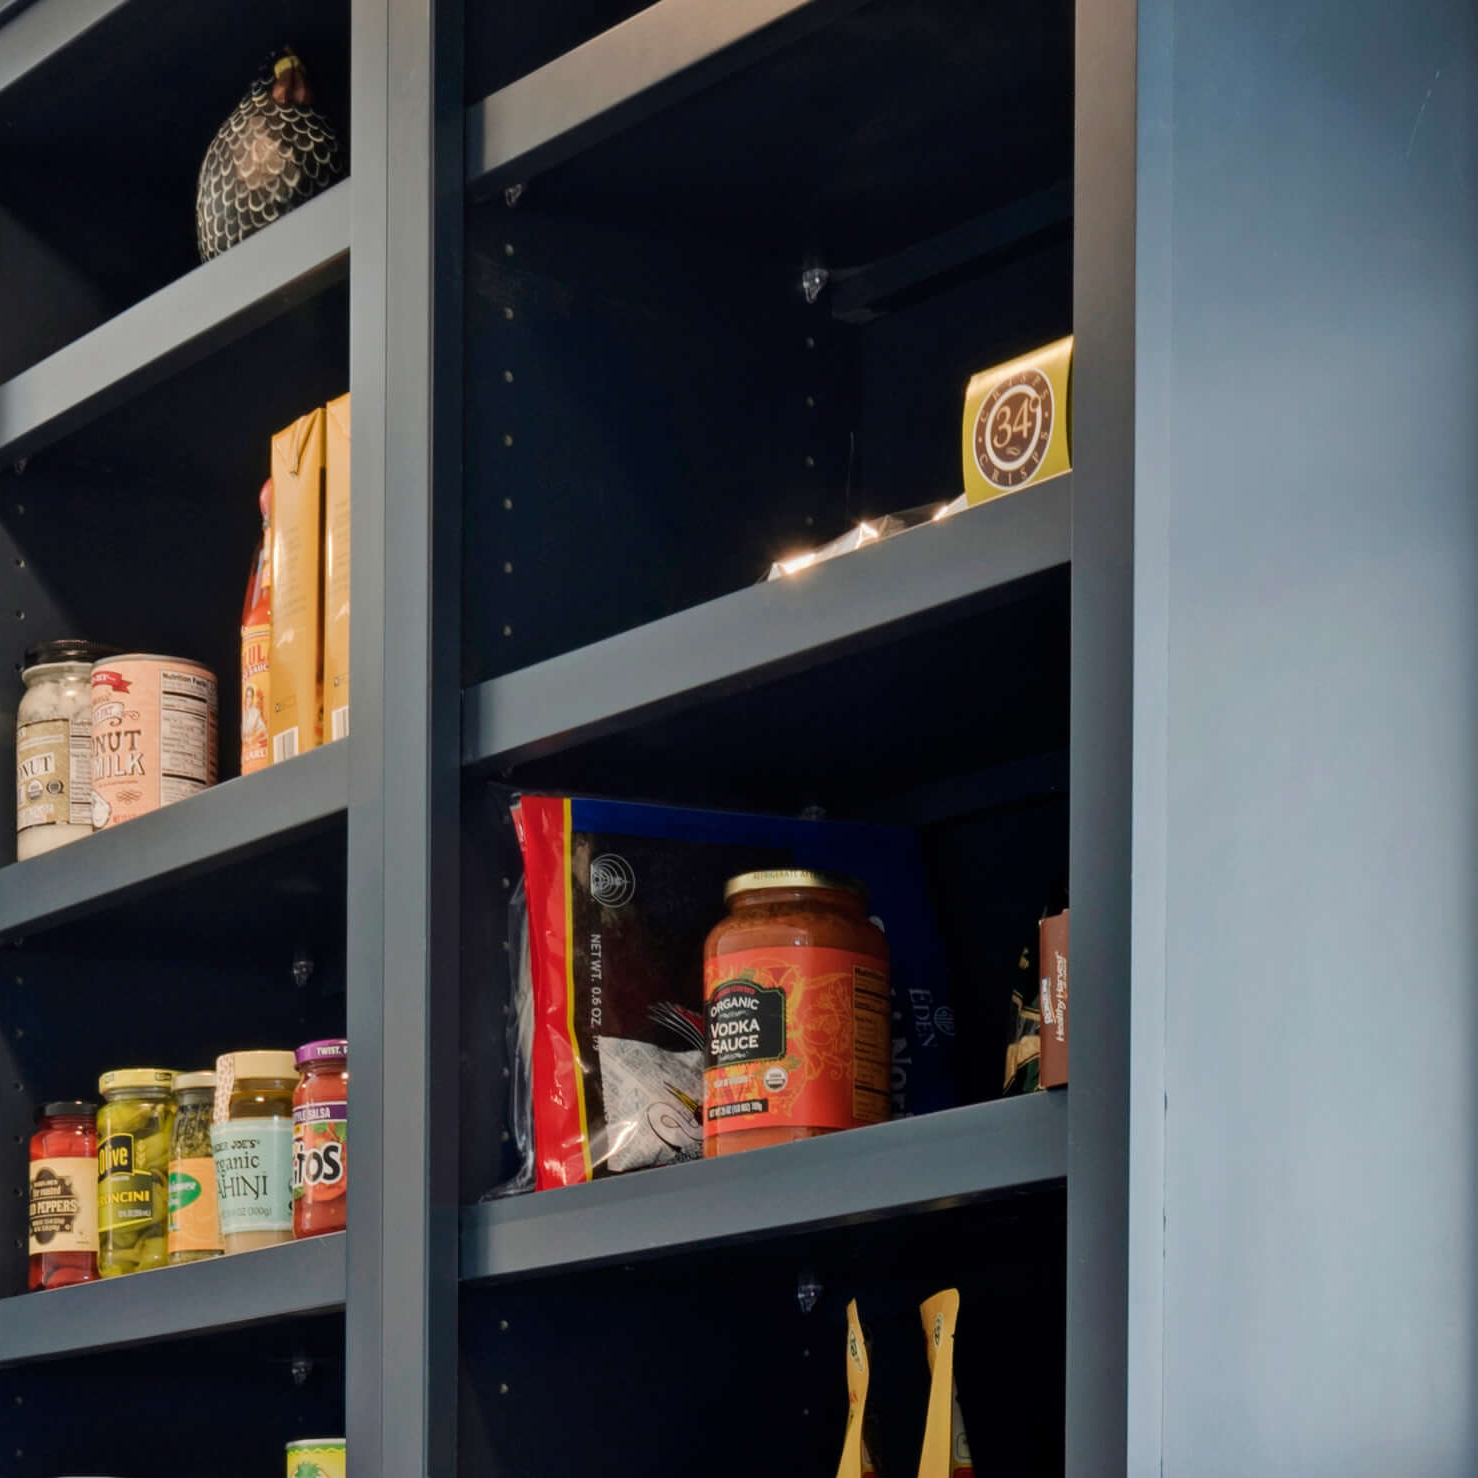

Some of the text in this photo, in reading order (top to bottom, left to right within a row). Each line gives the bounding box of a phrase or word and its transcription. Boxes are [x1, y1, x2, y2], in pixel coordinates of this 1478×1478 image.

[94, 752, 145, 778] MILK
[590, 933, 602, 958] NET
[590, 960, 602, 982] WT.
[710, 996, 760, 1018] ORGANIC
[1055, 952, 1066, 1042] Healthy Harvest
[710, 1018, 761, 1039] VODKA
[909, 988, 938, 1048] EDEN
[710, 1034, 759, 1056] SAUCE
[307, 1107, 331, 1120] SALSA
[231, 1139, 256, 1149] JOE'S
[37, 1199, 78, 1214] PEPPERS
